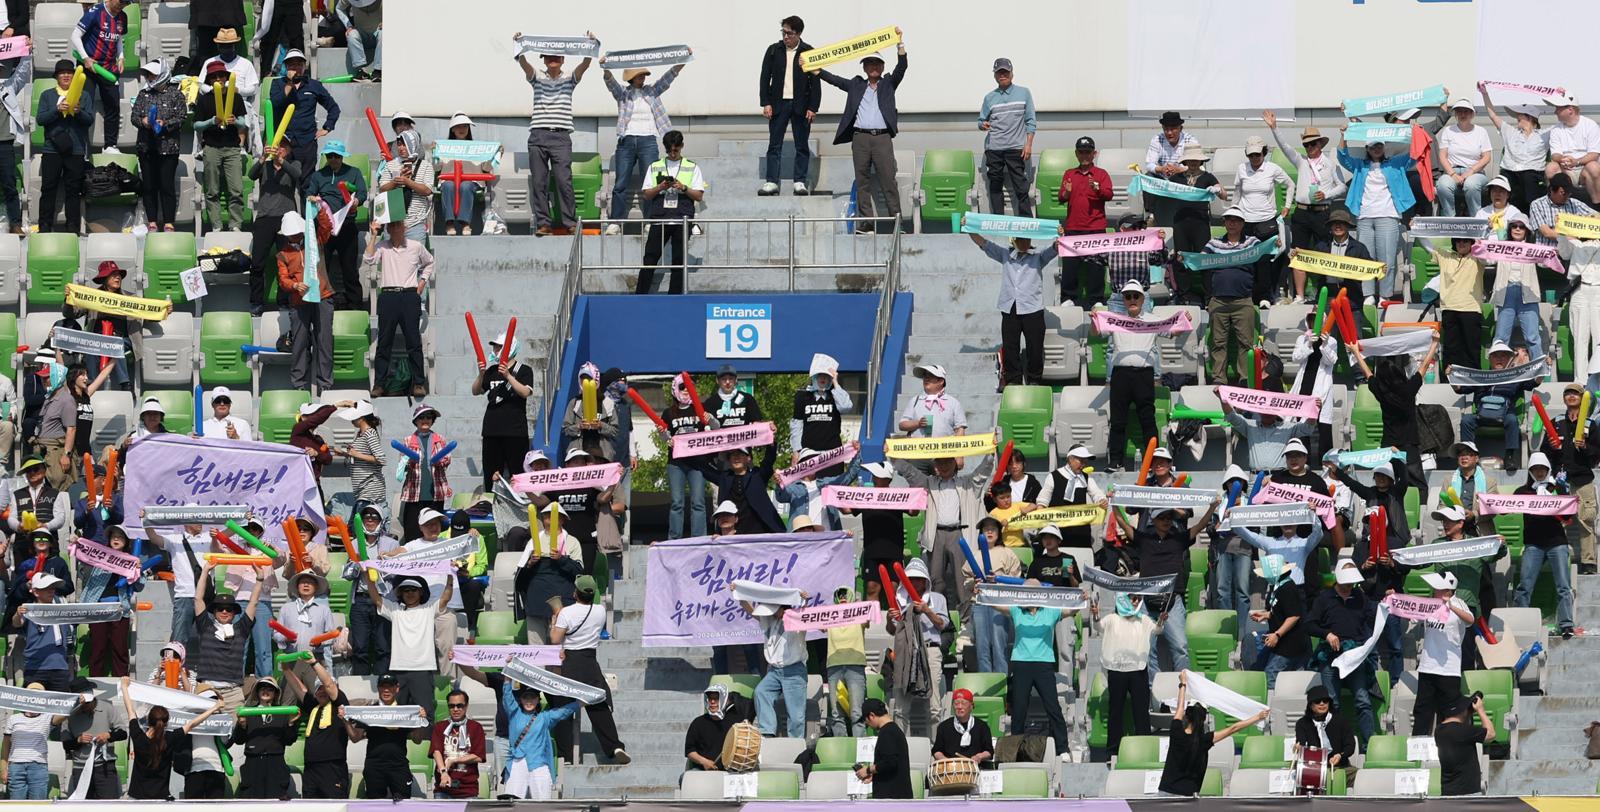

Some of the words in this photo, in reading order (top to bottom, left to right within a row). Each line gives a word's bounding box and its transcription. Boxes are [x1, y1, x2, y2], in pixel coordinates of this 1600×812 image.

[538, 41, 565, 50] BEYOND
[636, 51, 662, 60] BEYOND
[808, 53, 831, 64] 힘내라!
[831, 46, 851, 58] 우리가
[1073, 238, 1111, 249] 우리선수
[1113, 235, 1145, 247] 힘내라!
[1487, 244, 1522, 256] 우리선수
[1319, 259, 1338, 268] 우리가
[74, 291, 96, 303] 힘내라!
[98, 296, 119, 306] 우리가
[713, 306, 766, 318] Entrance
[719, 323, 759, 353] 19
[101, 340, 123, 350] VICTORY
[1228, 392, 1267, 406] 우리선수
[1270, 396, 1304, 410] 힘내라!
[687, 437, 724, 449] 우리선수
[726, 430, 757, 443] 힘내라!
[893, 443, 917, 452] 힘내라!
[918, 443, 940, 451] 우리가
[783, 458, 815, 477] 우리선수
[818, 446, 846, 465] 힘내라!
[178, 455, 290, 496] 힘내라!
[529, 472, 568, 484] 우리선수
[571, 469, 605, 481] 힘내라!
[558, 494, 588, 504] STAFF
[836, 490, 875, 502] 우리선수
[877, 490, 909, 503] 힘내라!
[1150, 493, 1182, 501] BEYOND
[1182, 494, 1214, 503] VICTORY
[1267, 485, 1304, 503] 우리선수
[1486, 498, 1525, 508] 우리선수
[1528, 499, 1562, 509] 힘내라!
[214, 511, 245, 519] VICTORY
[1251, 510, 1279, 519] BEYOND
[1279, 508, 1310, 517] VICTORY
[417, 547, 445, 560] BEYOND
[1433, 546, 1463, 556] BEYOND
[1464, 542, 1495, 553] VICTORY
[107, 554, 136, 571] 힘내라!
[691, 554, 798, 597] 힘내라!
[1017, 591, 1049, 600] BEYOND
[1049, 592, 1081, 601] VICTORY
[671, 599, 717, 627] 우리가
[801, 610, 839, 624] 우리선수
[540, 673, 569, 690] BEYOND
[15, 693, 46, 705] BEYOND
[443, 736, 472, 748] NOA
